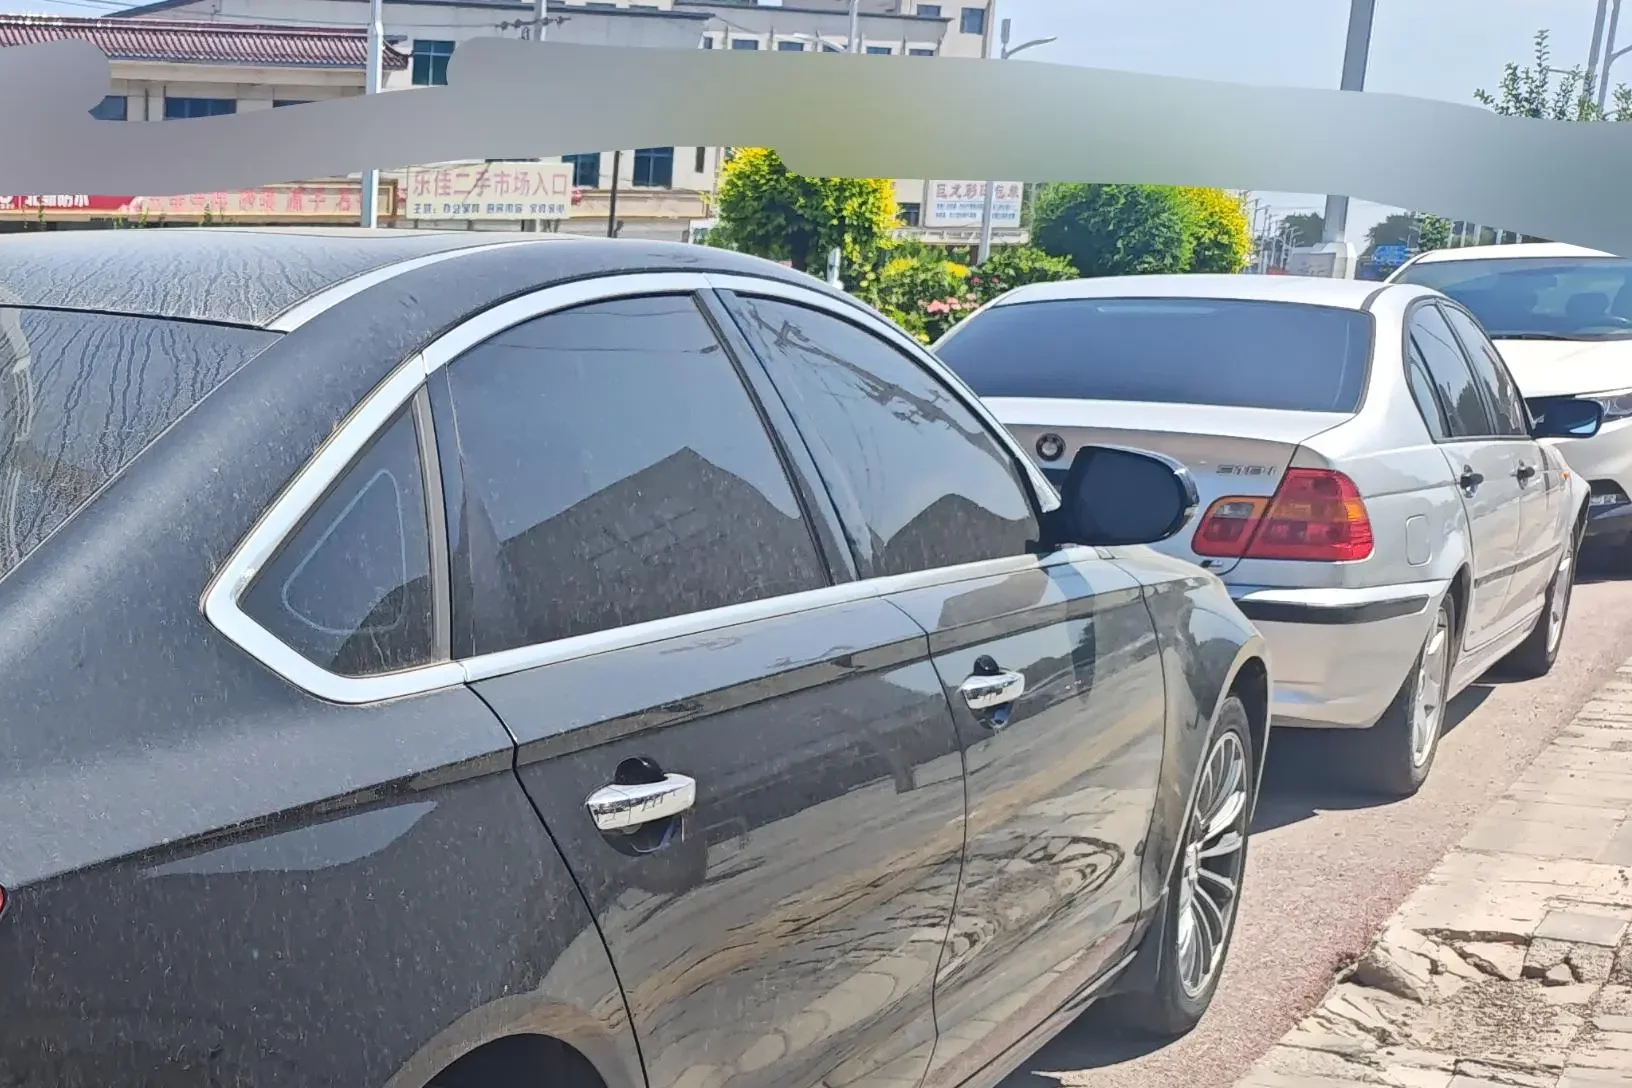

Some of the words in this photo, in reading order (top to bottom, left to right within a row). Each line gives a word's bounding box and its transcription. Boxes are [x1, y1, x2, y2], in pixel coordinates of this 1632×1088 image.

[412, 169, 568, 198] 乐佳二手市场入口
